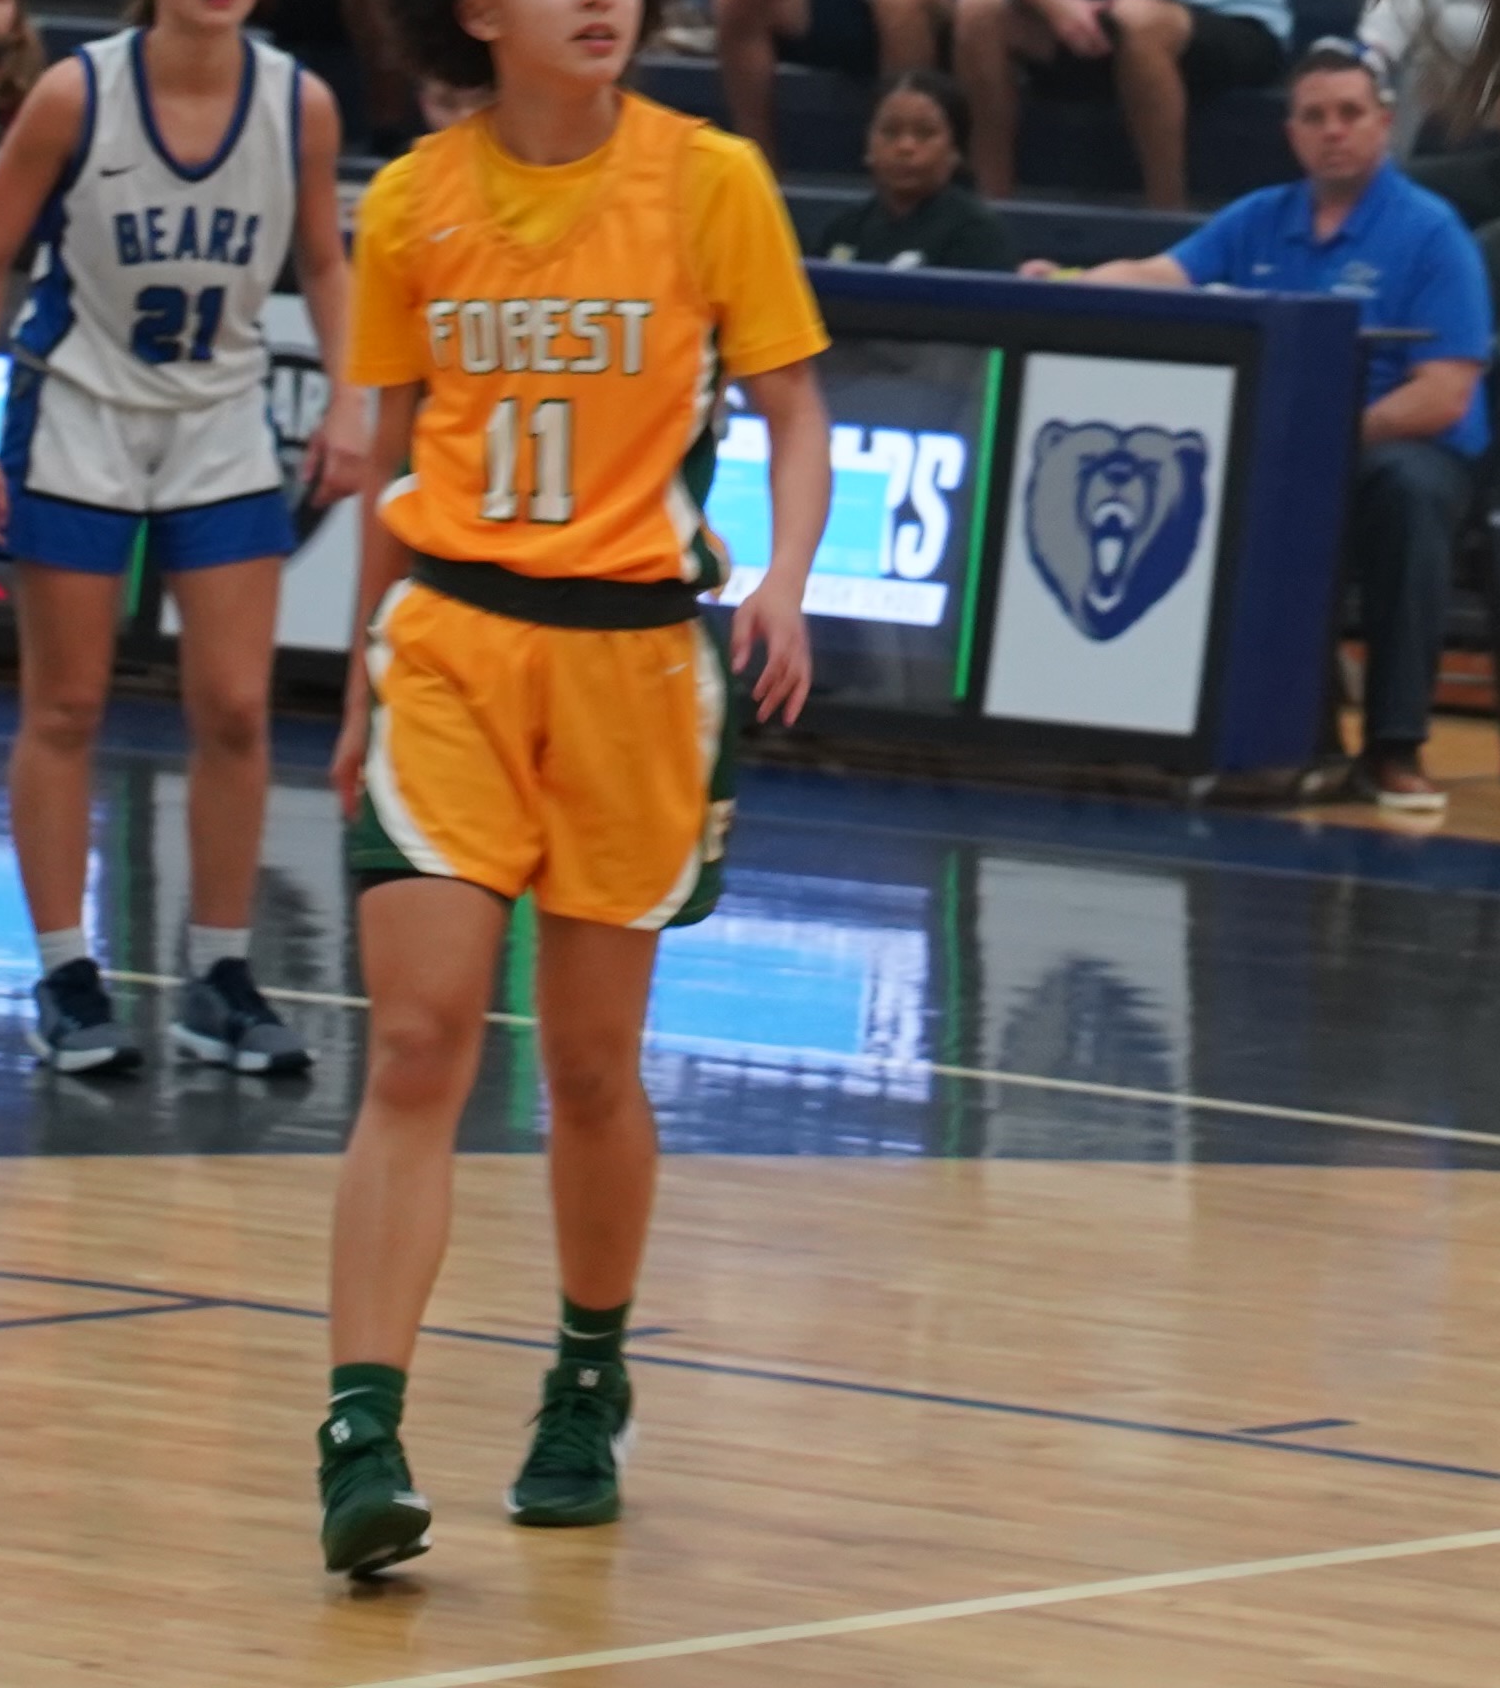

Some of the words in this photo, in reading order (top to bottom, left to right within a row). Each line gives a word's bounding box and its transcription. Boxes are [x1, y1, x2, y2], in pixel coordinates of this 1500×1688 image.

[114, 205, 260, 267] BEARS
[131, 284, 227, 364] 21
[426, 296, 655, 375] FOREST
[480, 396, 574, 523] 11
